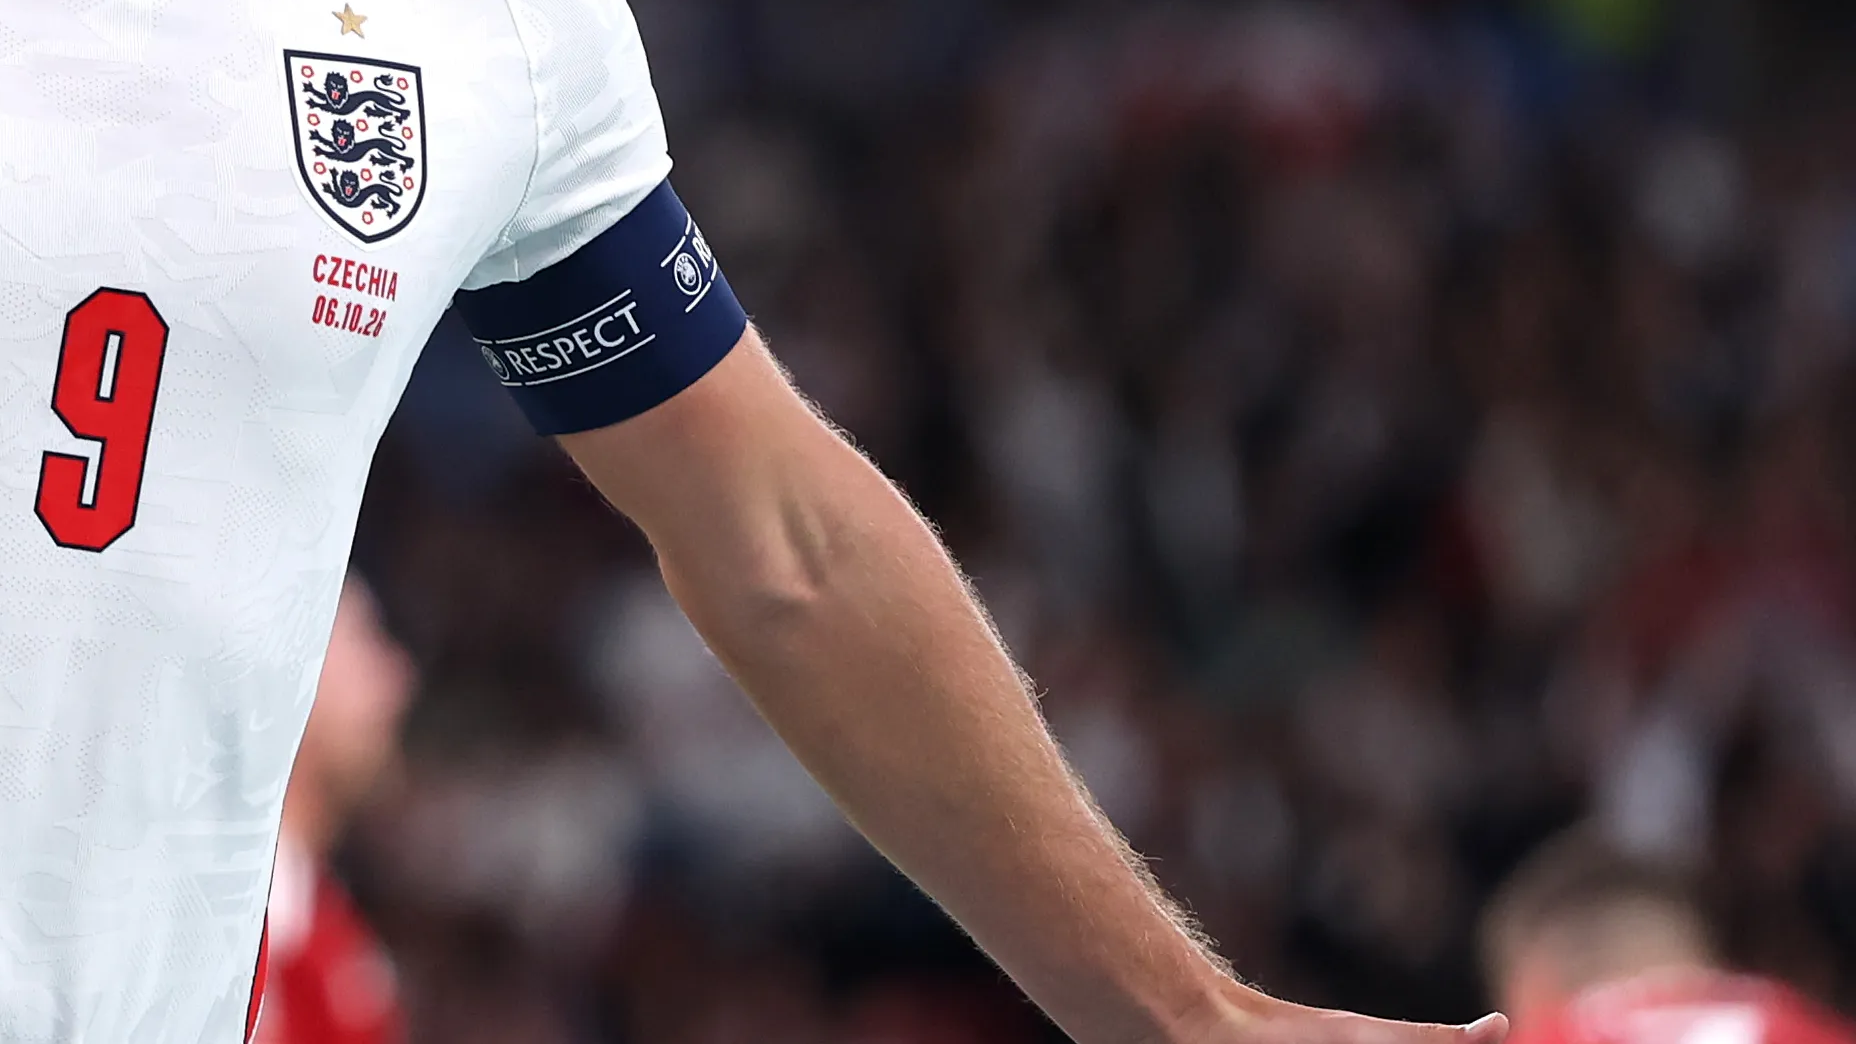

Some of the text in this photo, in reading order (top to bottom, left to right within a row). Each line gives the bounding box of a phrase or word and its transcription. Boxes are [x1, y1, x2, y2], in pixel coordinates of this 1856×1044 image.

[312, 254, 398, 302] CZECHIA
[504, 301, 641, 376] RESPECT
[33, 286, 170, 553] 9
